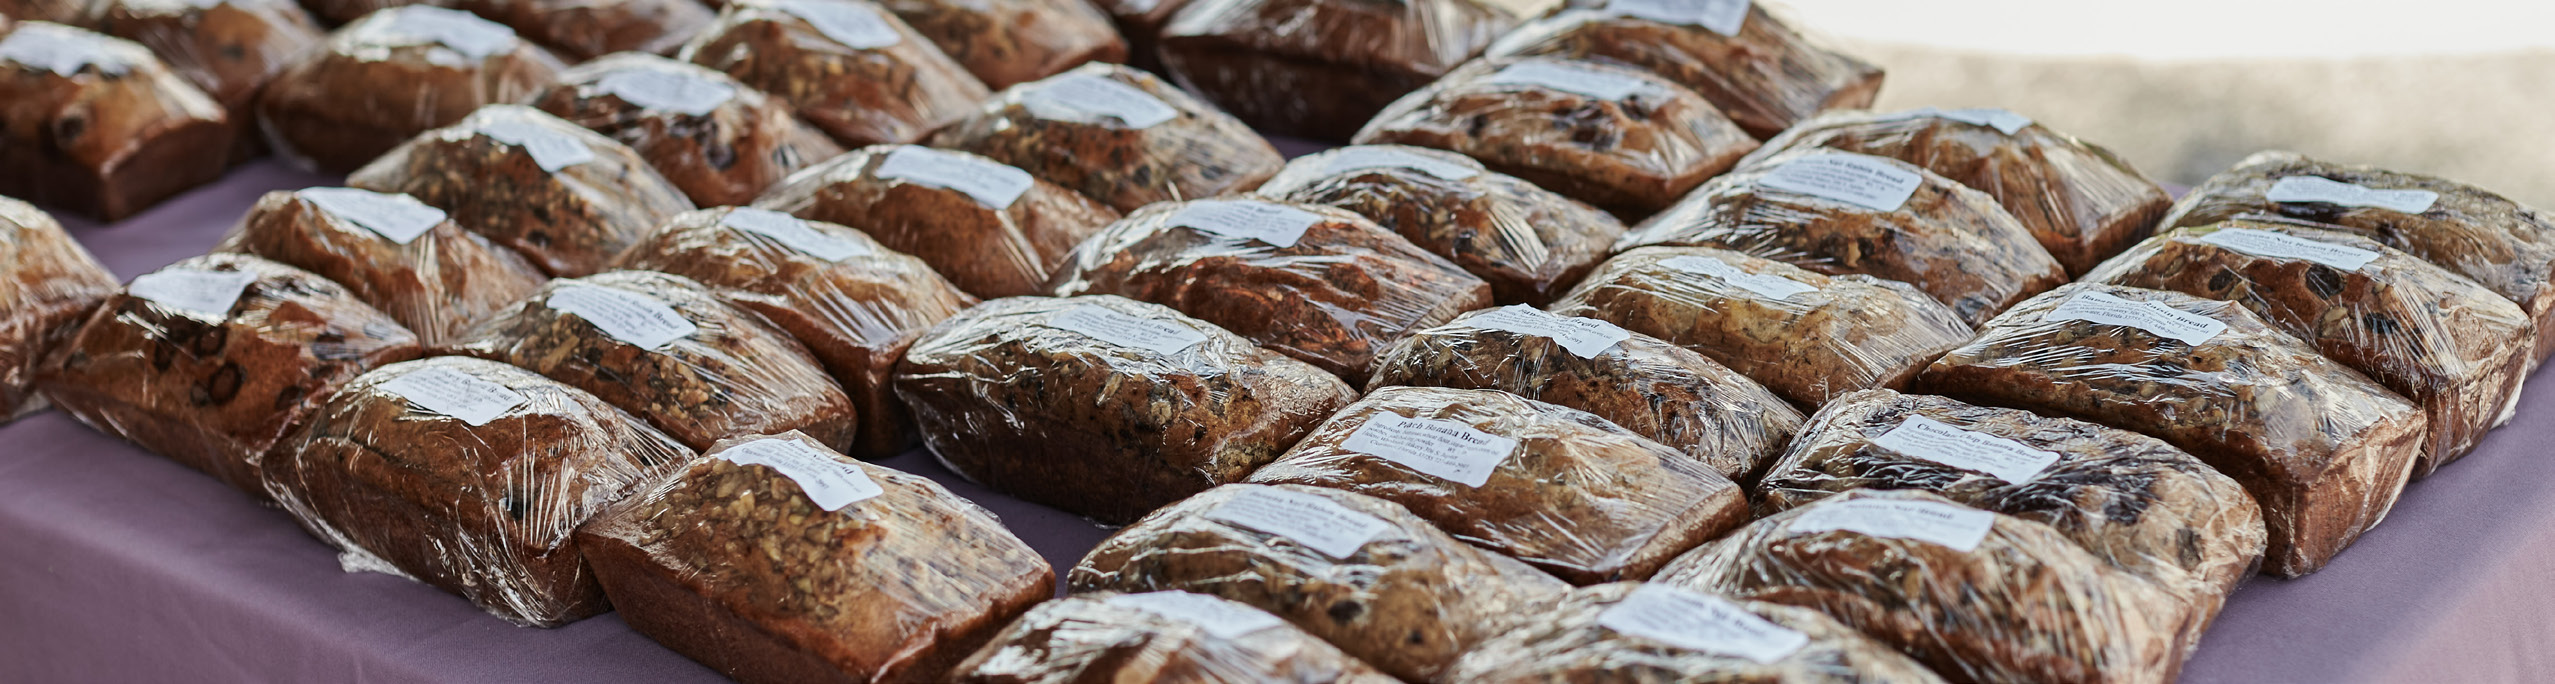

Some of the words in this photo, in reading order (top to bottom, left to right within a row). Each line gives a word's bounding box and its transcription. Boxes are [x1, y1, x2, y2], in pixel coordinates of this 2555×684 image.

[2081, 294, 2118, 304] Banan
[2176, 315, 2209, 329] Bread
[1425, 423, 1459, 438] Banana
[1461, 431, 1491, 446] Bread
